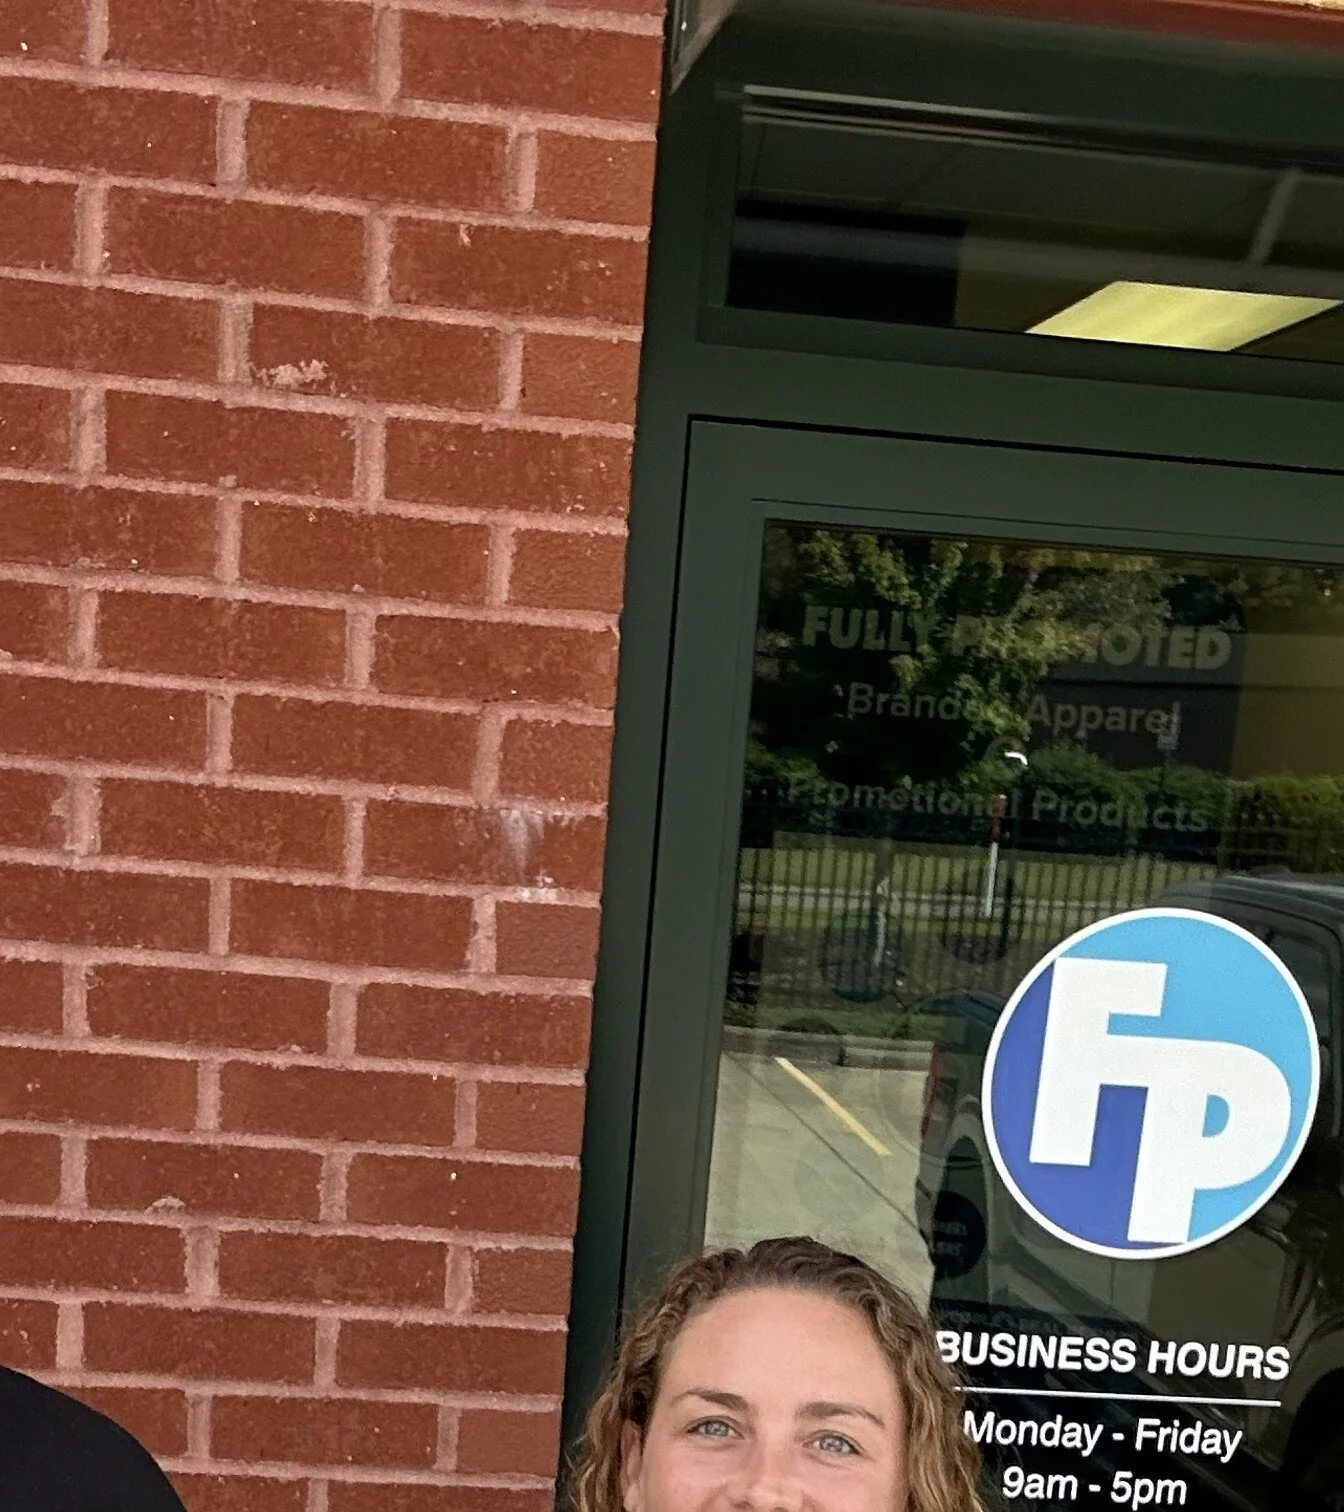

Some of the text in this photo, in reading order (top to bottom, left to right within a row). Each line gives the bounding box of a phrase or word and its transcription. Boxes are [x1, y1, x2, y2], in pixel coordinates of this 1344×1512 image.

[1026, 699, 1181, 741] Apparel
[1031, 791, 1209, 832] Products
[1029, 957, 1291, 1243] FP
[936, 1330, 1291, 1381] BUSINESS HOURS
[963, 1411, 1103, 1457] Monday
[1135, 1418, 1243, 1463] Friday
[1002, 1466, 1078, 1500] 9am
[1110, 1470, 1187, 1511] 5pm
